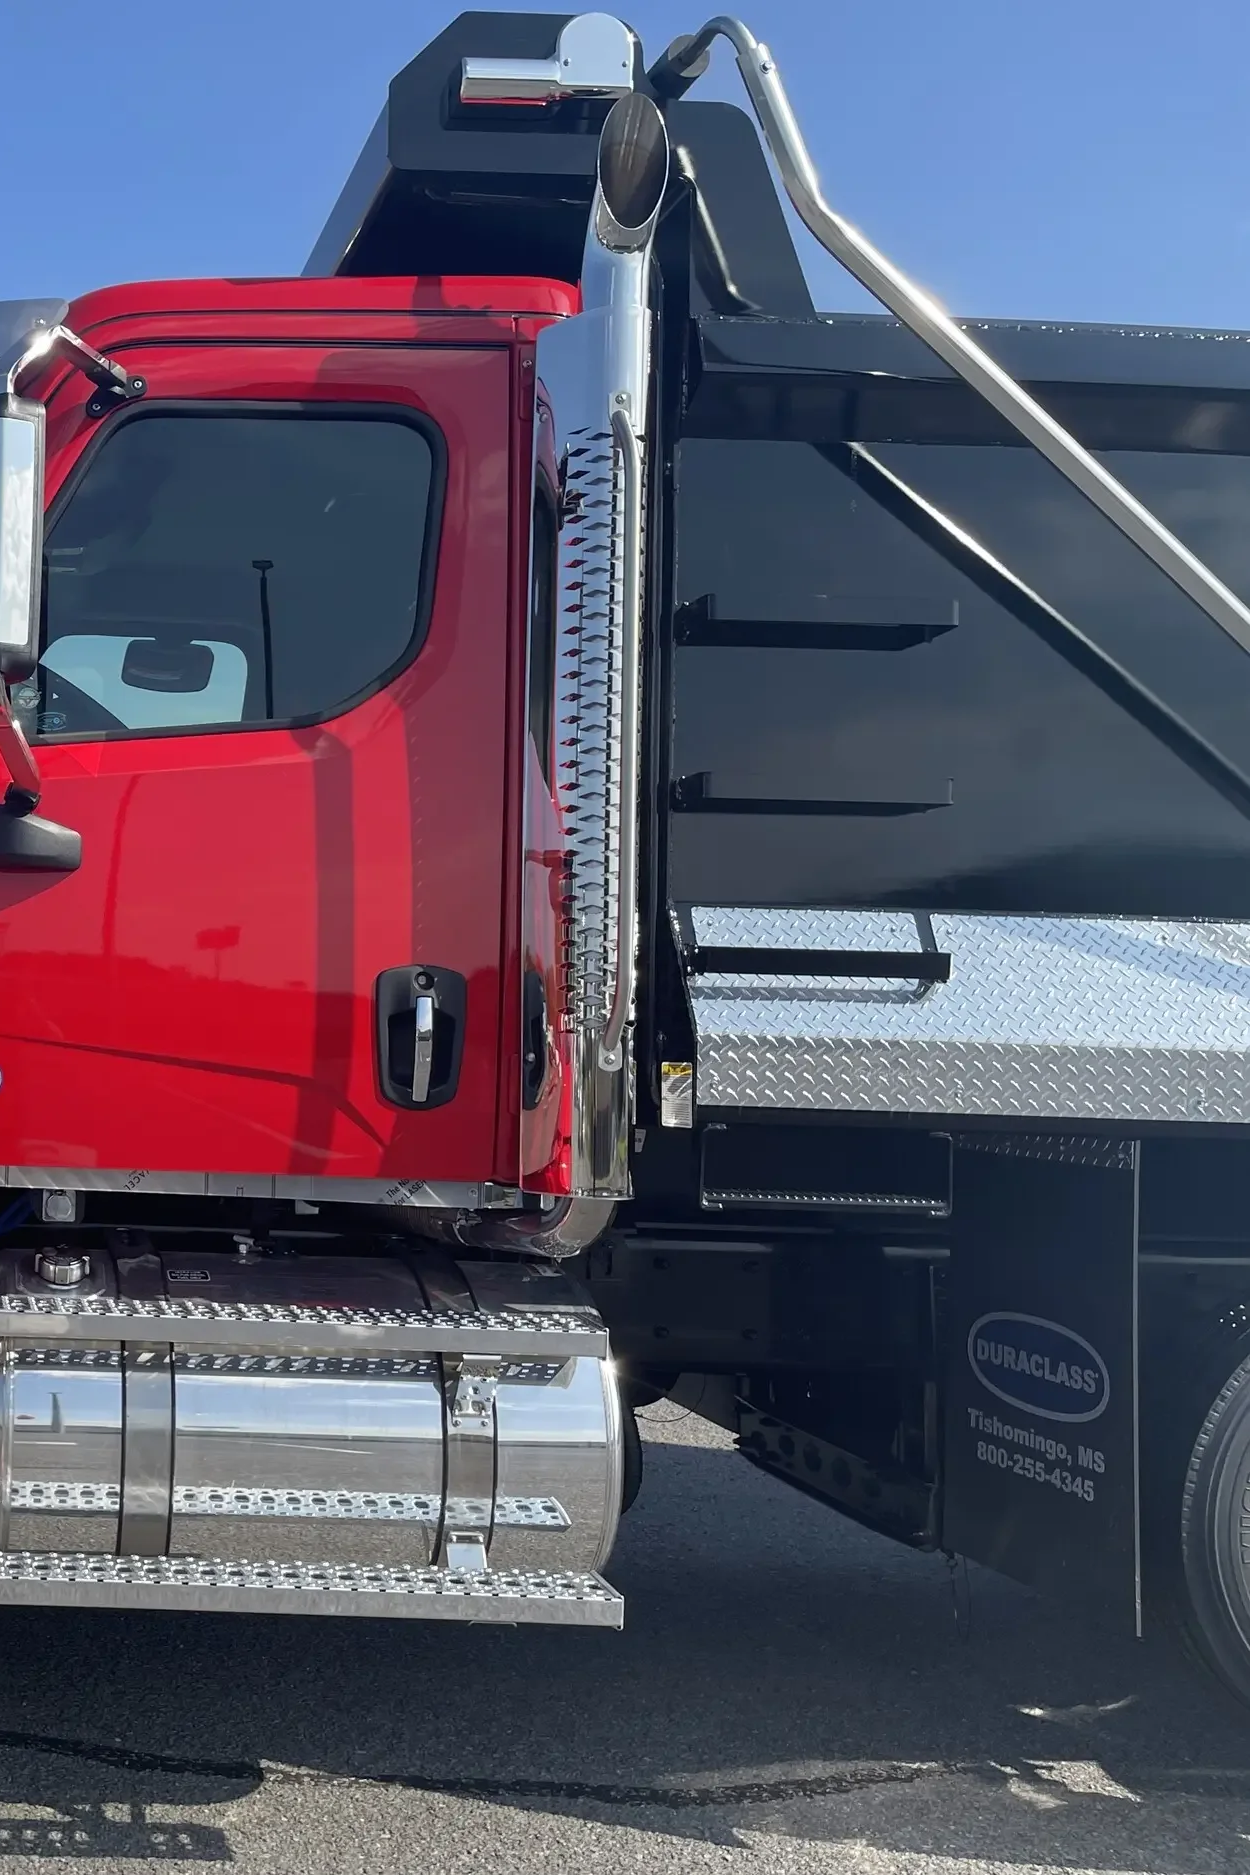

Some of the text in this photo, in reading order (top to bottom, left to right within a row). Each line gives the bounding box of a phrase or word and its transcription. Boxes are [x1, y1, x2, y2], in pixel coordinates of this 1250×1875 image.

[976, 1338, 1098, 1394] DURACLASS
[967, 1407, 1106, 1473] Tishomingo, MS
[976, 1440, 1095, 1502] 800-255-4345
